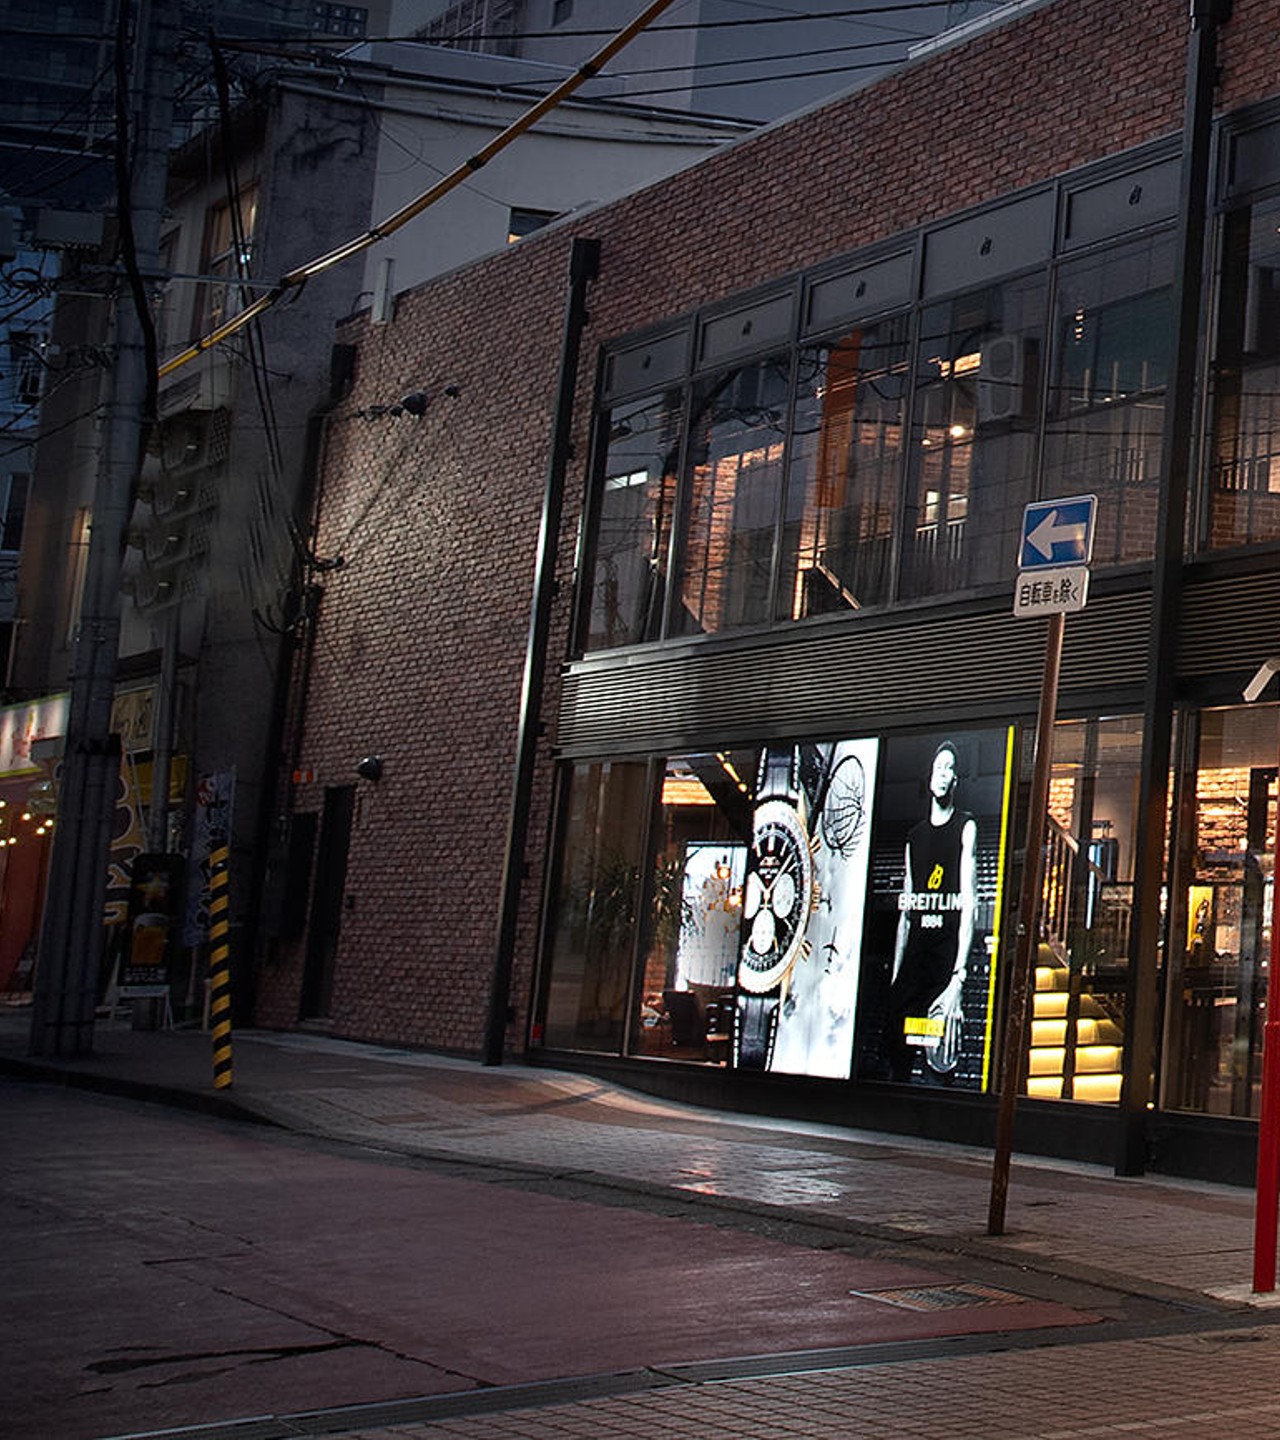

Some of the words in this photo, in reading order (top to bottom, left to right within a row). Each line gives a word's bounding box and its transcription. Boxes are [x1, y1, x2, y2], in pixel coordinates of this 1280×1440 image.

[1019, 577, 1079, 606] 自転車を除く
[897, 892, 977, 912] BREITLIN
